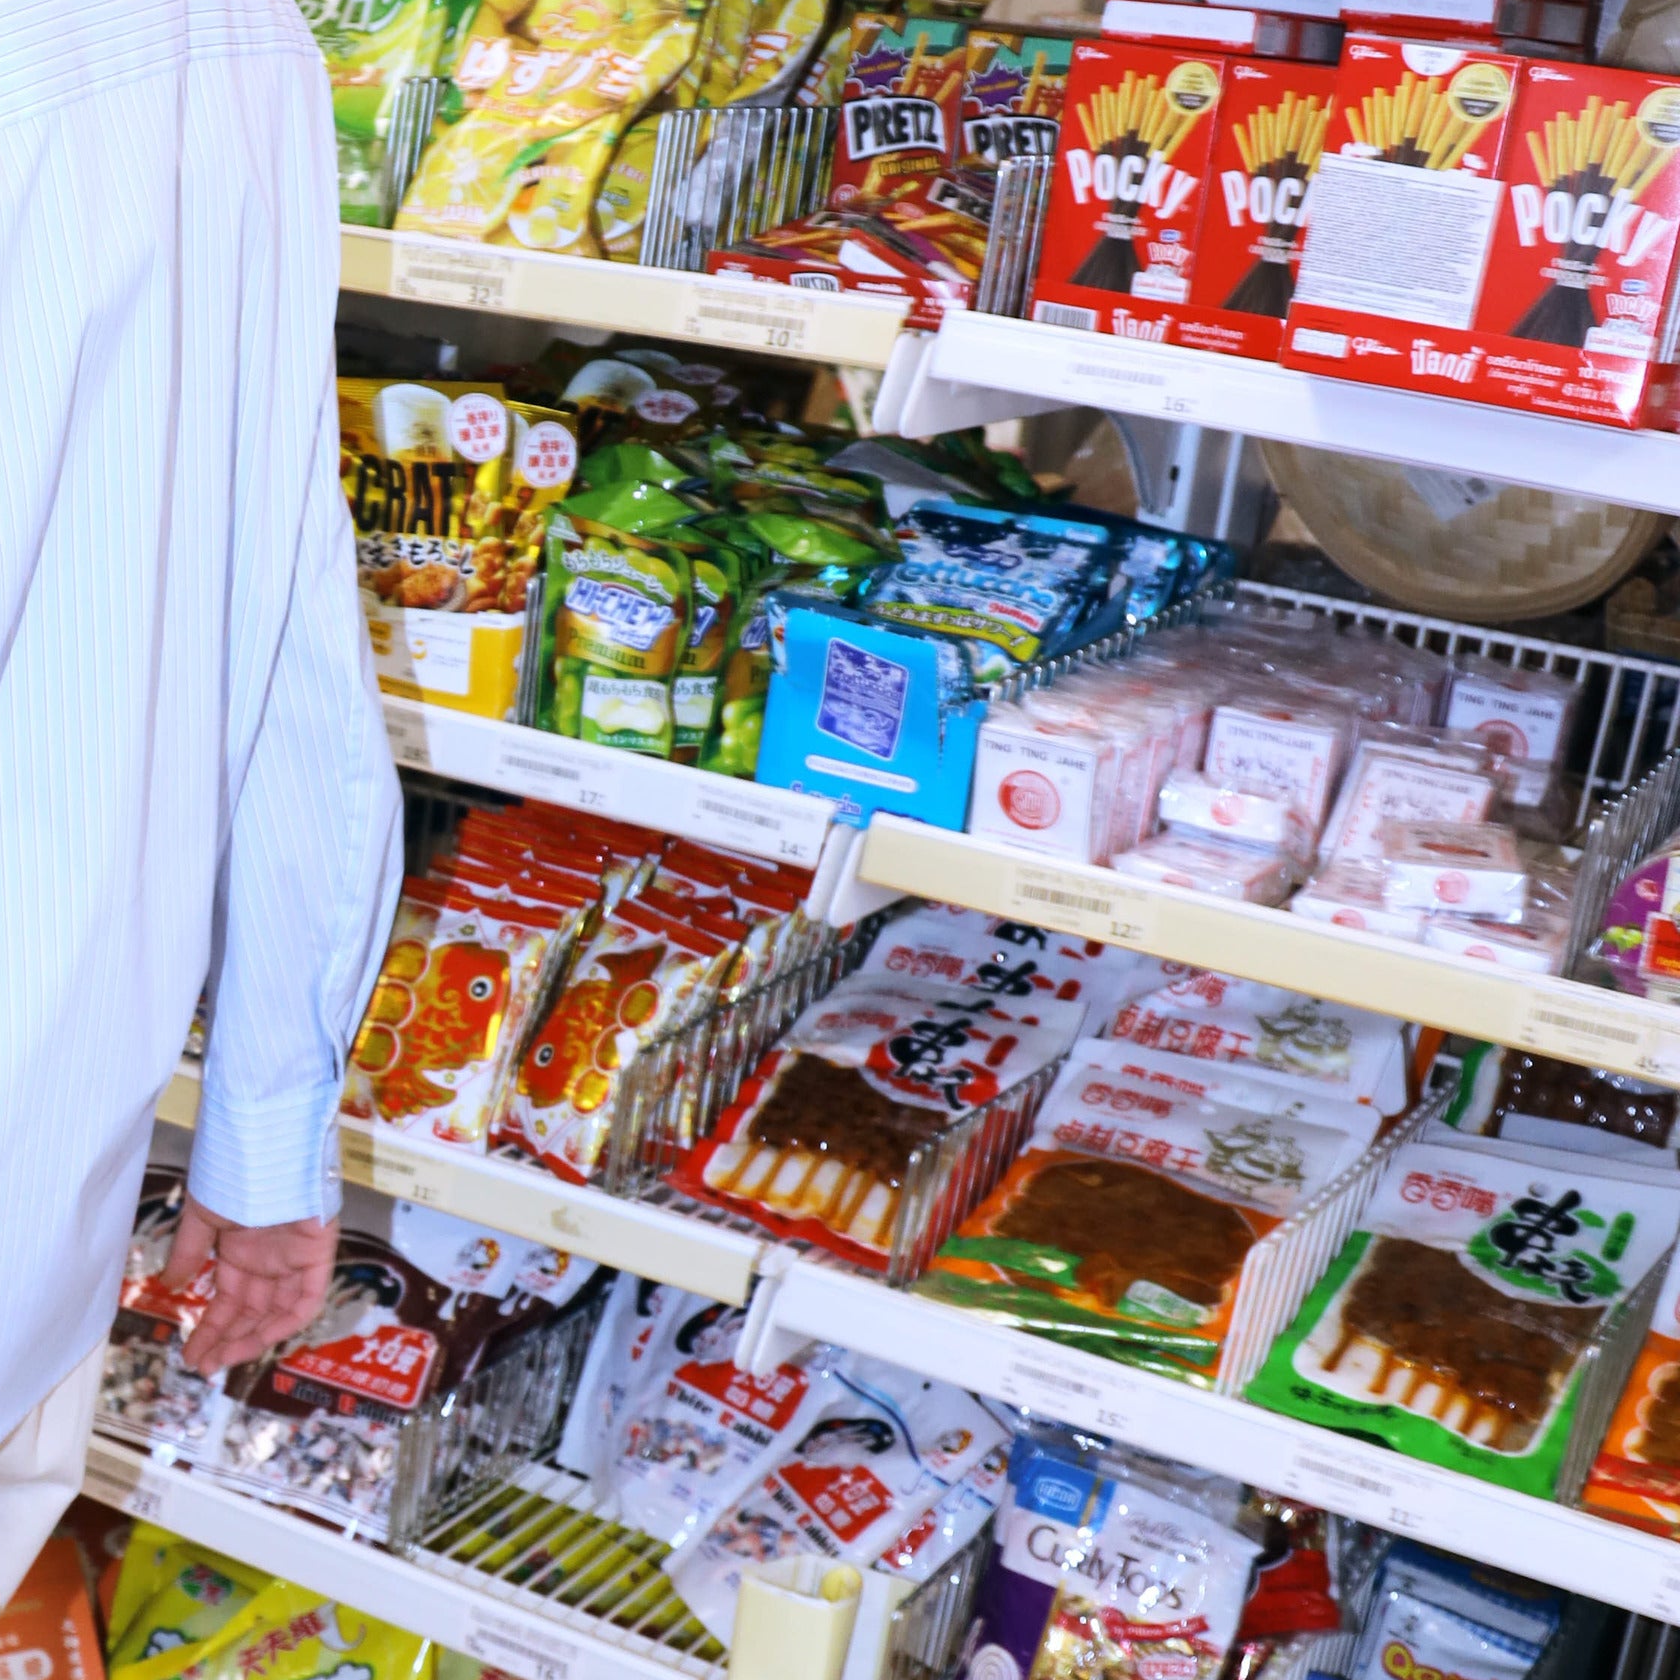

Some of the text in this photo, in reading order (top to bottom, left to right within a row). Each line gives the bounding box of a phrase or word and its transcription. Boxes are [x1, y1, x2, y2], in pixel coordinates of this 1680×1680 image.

[854, 102, 939, 153] PRETZ
[1066, 148, 1200, 220] POCKY
[1511, 181, 1670, 267] POCKY
[355, 453, 469, 536] CRAT
[565, 576, 676, 625] HI-CHEW
[982, 738, 1088, 772] TING TING JAHE
[1026, 1523, 1115, 1591] Culy
